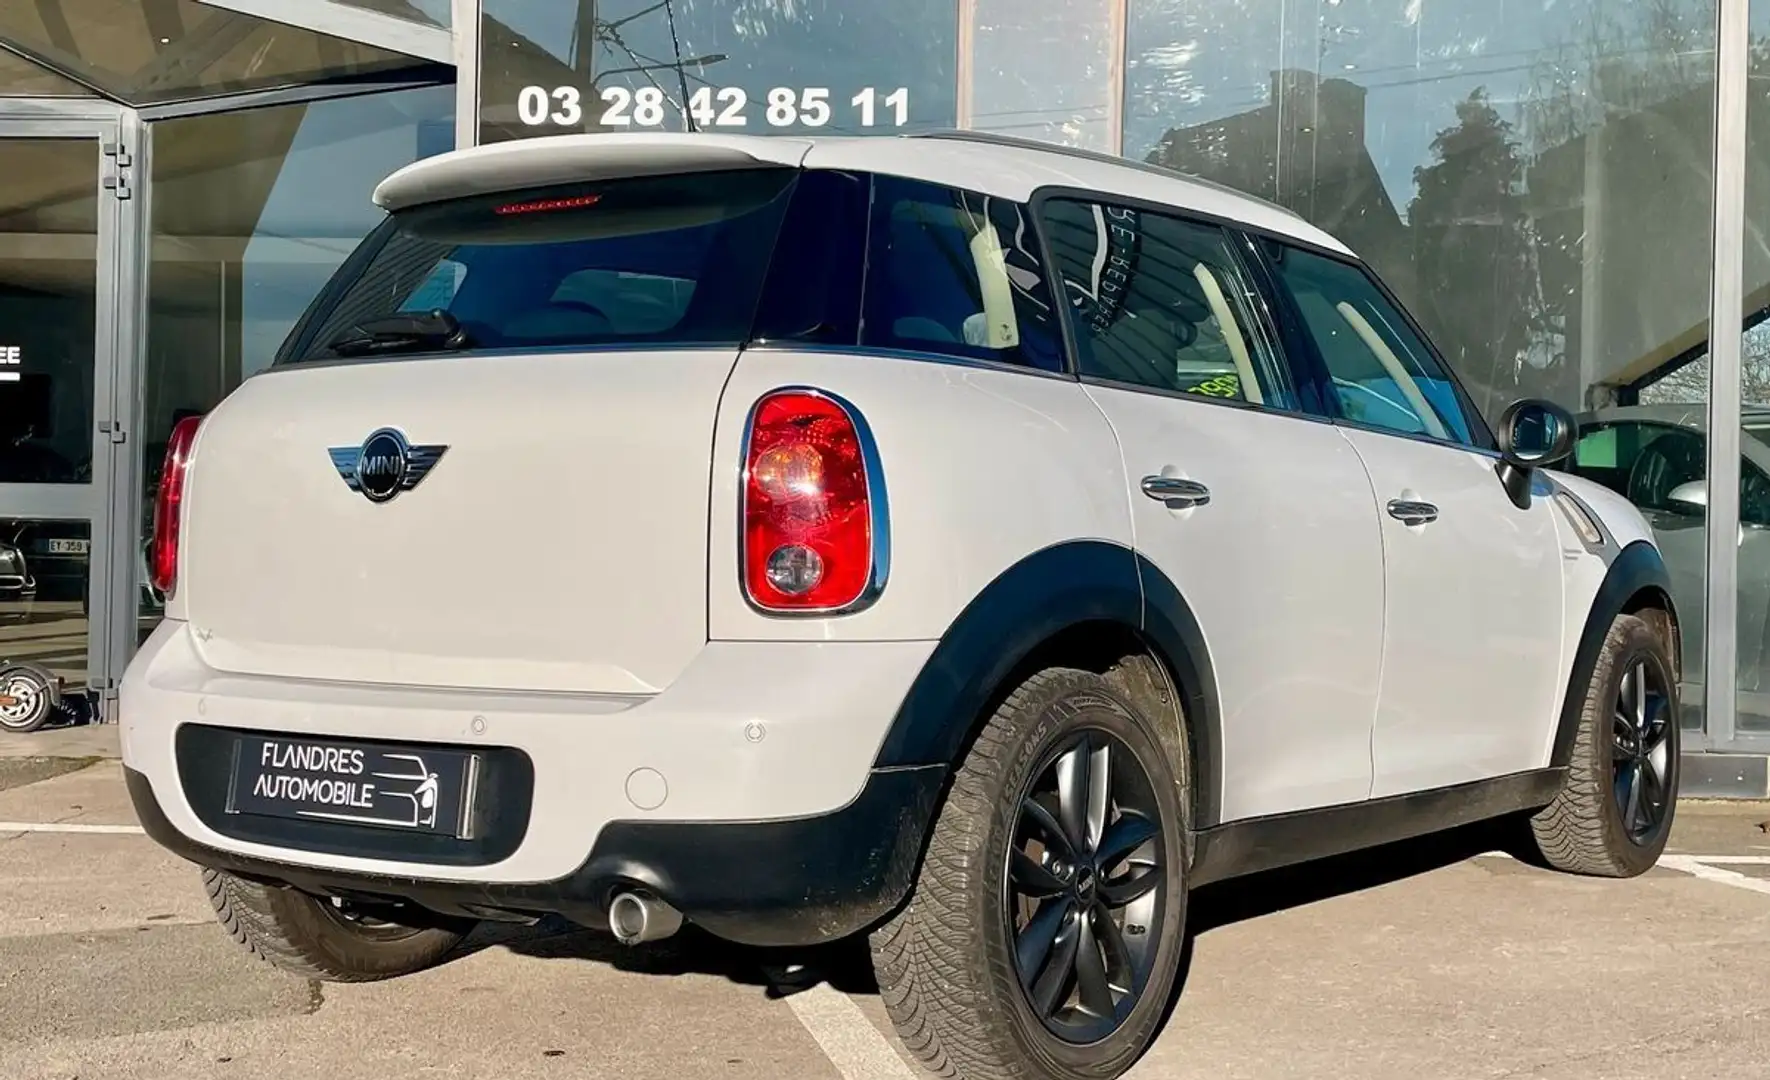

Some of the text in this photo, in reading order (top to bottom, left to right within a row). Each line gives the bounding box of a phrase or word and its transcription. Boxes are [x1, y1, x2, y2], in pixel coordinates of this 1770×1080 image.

[518, 86, 908, 126] 03 28 42 85 11
[362, 455, 400, 475] MINI
[260, 741, 365, 776] FLANDRES
[253, 773, 376, 809] AUTOMOBILE
